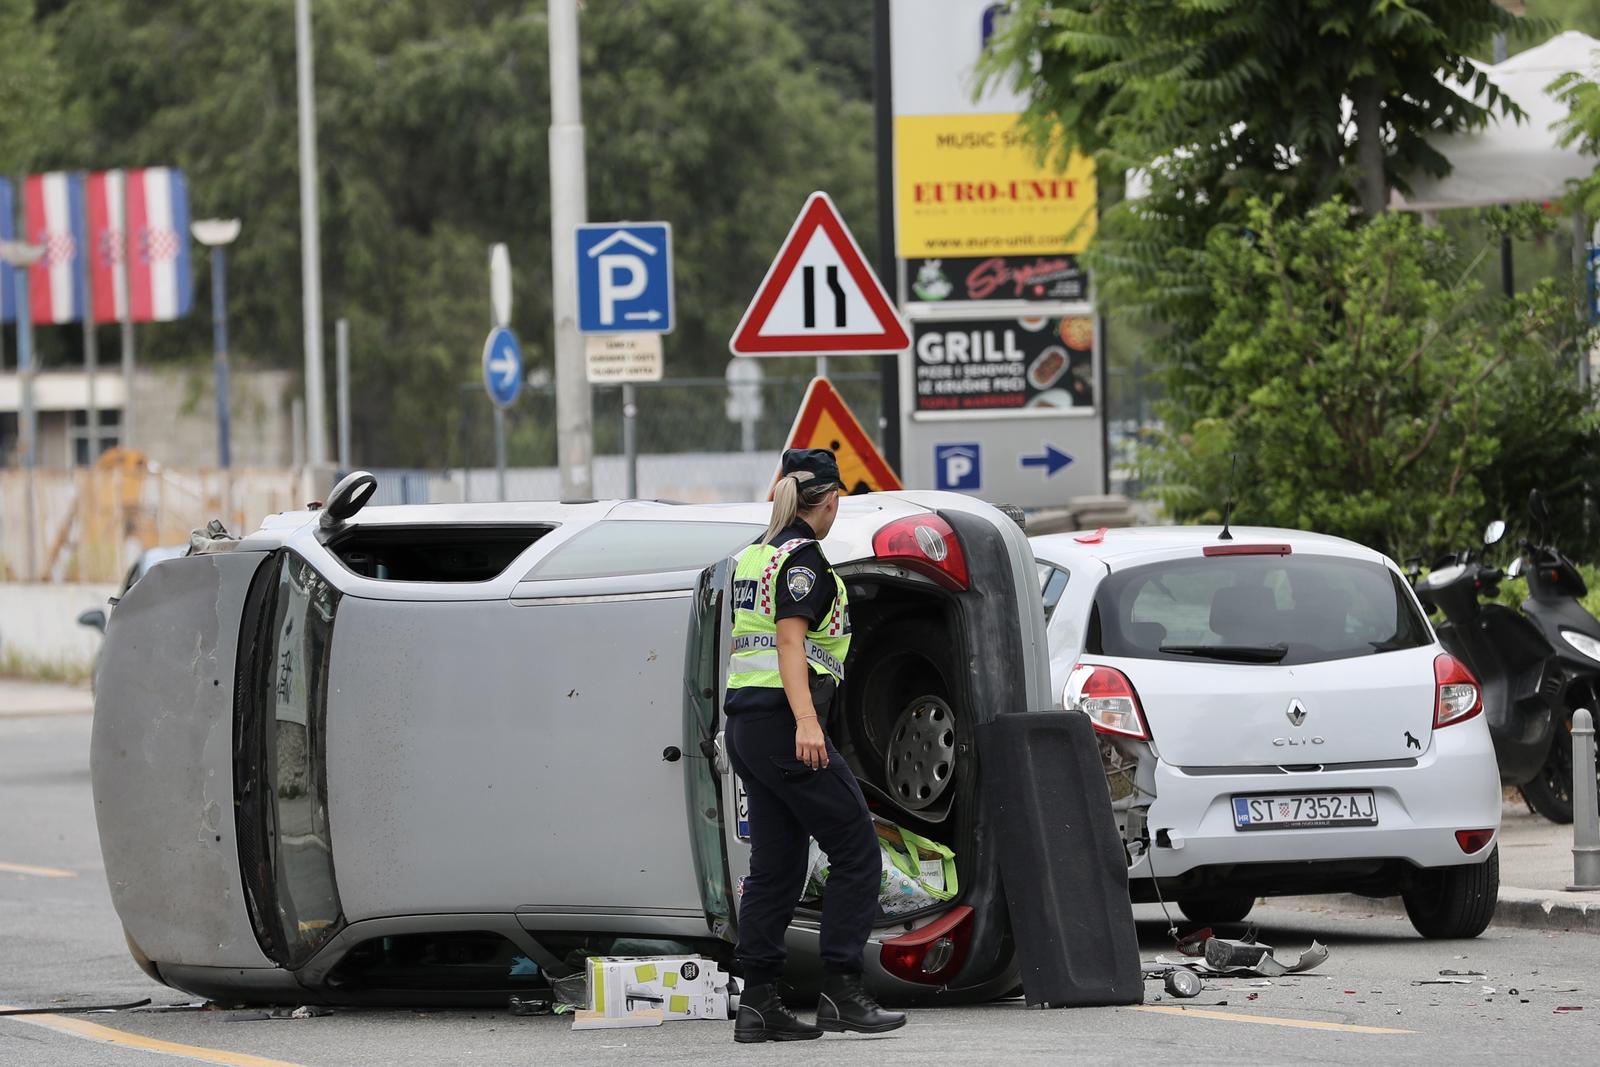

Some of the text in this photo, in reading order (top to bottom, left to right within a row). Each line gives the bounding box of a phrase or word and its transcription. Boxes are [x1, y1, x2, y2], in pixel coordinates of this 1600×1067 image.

[935, 131, 995, 149] MUSIC
[913, 178, 1079, 205] EURO-UNIT
[598, 254, 648, 325] P
[917, 329, 1025, 364] GRILL
[811, 645, 842, 676] POLICIJA
[1272, 735, 1325, 746] CLIO
[1250, 800, 1275, 822] ST
